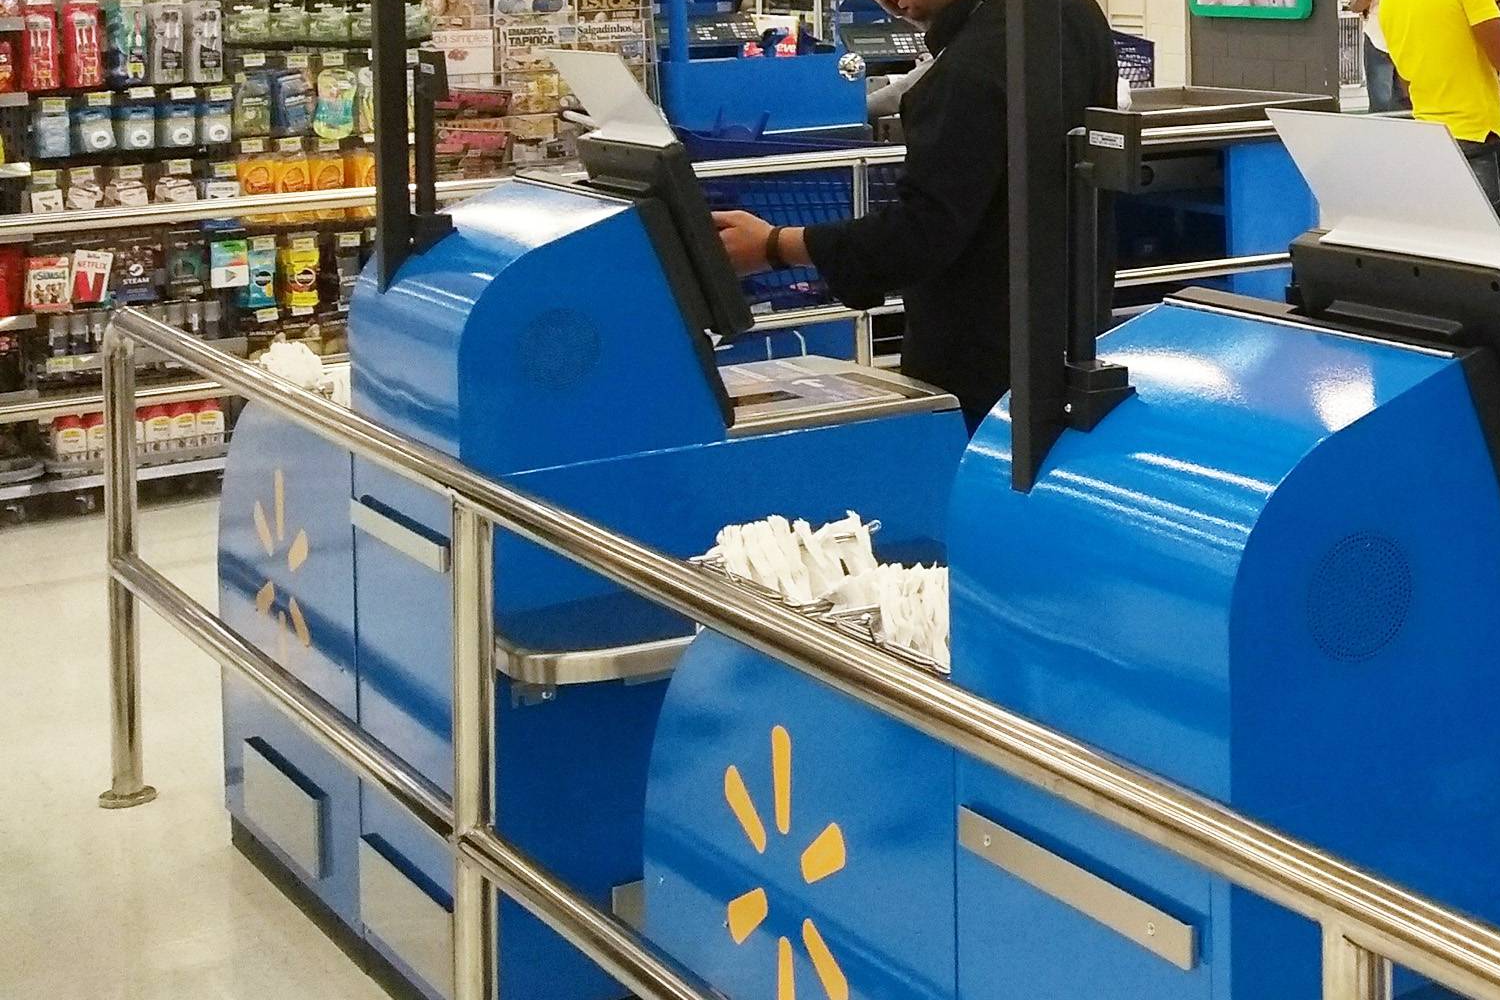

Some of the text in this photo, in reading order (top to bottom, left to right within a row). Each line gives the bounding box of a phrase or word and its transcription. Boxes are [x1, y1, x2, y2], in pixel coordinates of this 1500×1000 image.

[577, 22, 633, 35] Salgadinhos
[776, 43, 797, 53] eve
[122, 276, 150, 286] STEAM
